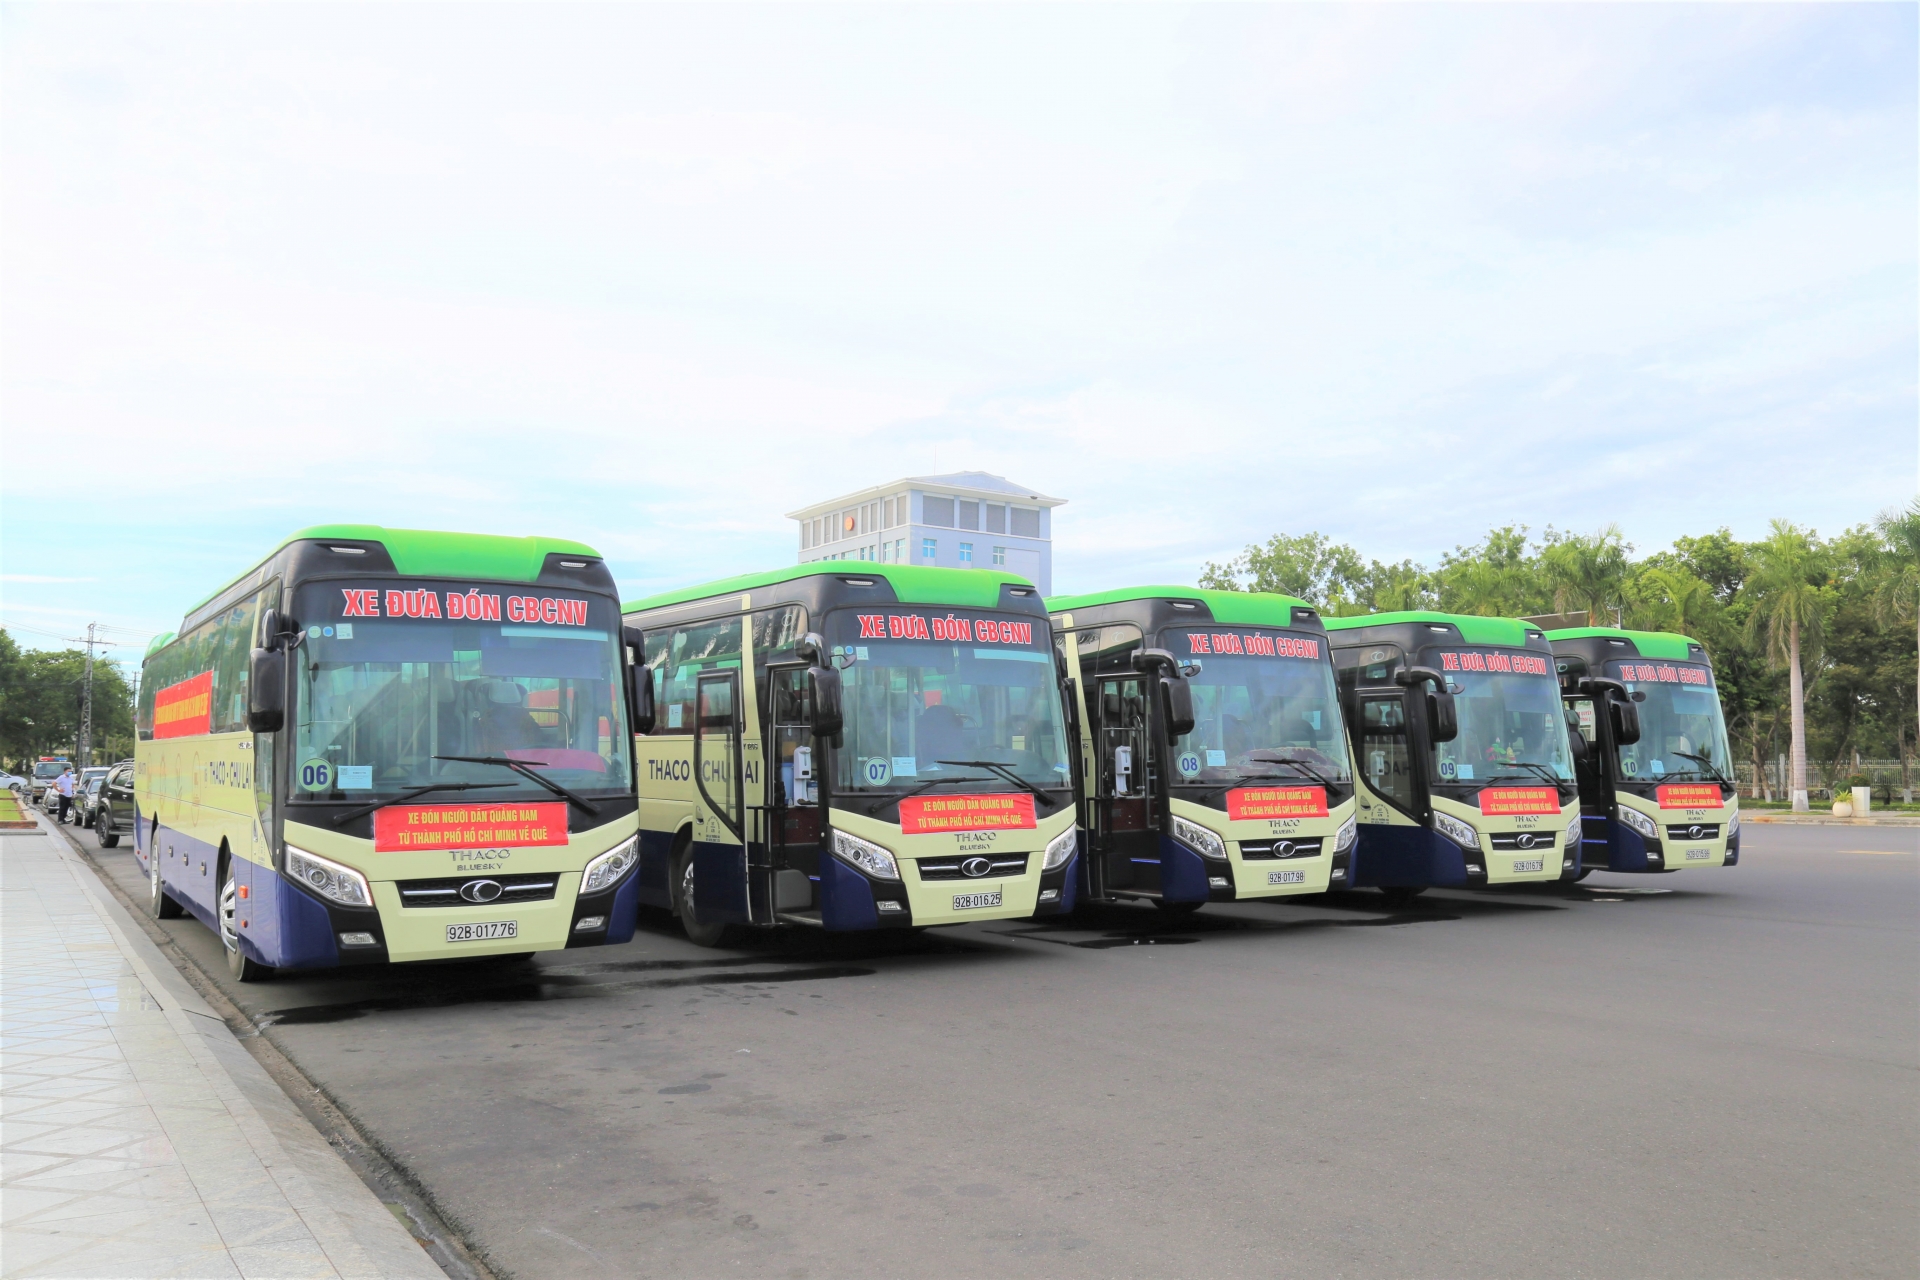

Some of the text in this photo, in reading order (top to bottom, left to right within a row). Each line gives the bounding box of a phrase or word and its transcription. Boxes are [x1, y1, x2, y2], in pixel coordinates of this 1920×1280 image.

[341, 588, 588, 626] XE ĐƯA ĐÓN CBCNV
[857, 613, 1031, 644] XE ĐƯA ĐÓN CBCNV
[1187, 634, 1211, 654] XE
[1211, 632, 1244, 654] ĐƯA
[1244, 632, 1275, 656] ĐÓN
[1440, 653, 1460, 670] XE
[1460, 652, 1486, 671] ĐƯA
[1619, 665, 1636, 681] XE
[648, 759, 690, 781] THACO
[869, 763, 887, 780] 07
[1182, 757, 1198, 771] 08
[1441, 762, 1455, 775] 09
[1624, 761, 1636, 773] 10
[210, 761, 225, 785] THACO
[303, 764, 328, 786] 06
[923, 801, 932, 812] XE
[408, 808, 538, 824] XE ĐÓN NGƯỜI DÂN QUẢNG NAM
[398, 825, 547, 845] TỪ THÀNH PHỐ HỒ CHÍ MINH VỀ QUÊ
[954, 832, 996, 842] THACO
[449, 849, 511, 861] THACO
[457, 863, 503, 871] BLUESKY
[955, 894, 1001, 908] 92B-016.25
[449, 922, 514, 940] 92B-017.76
